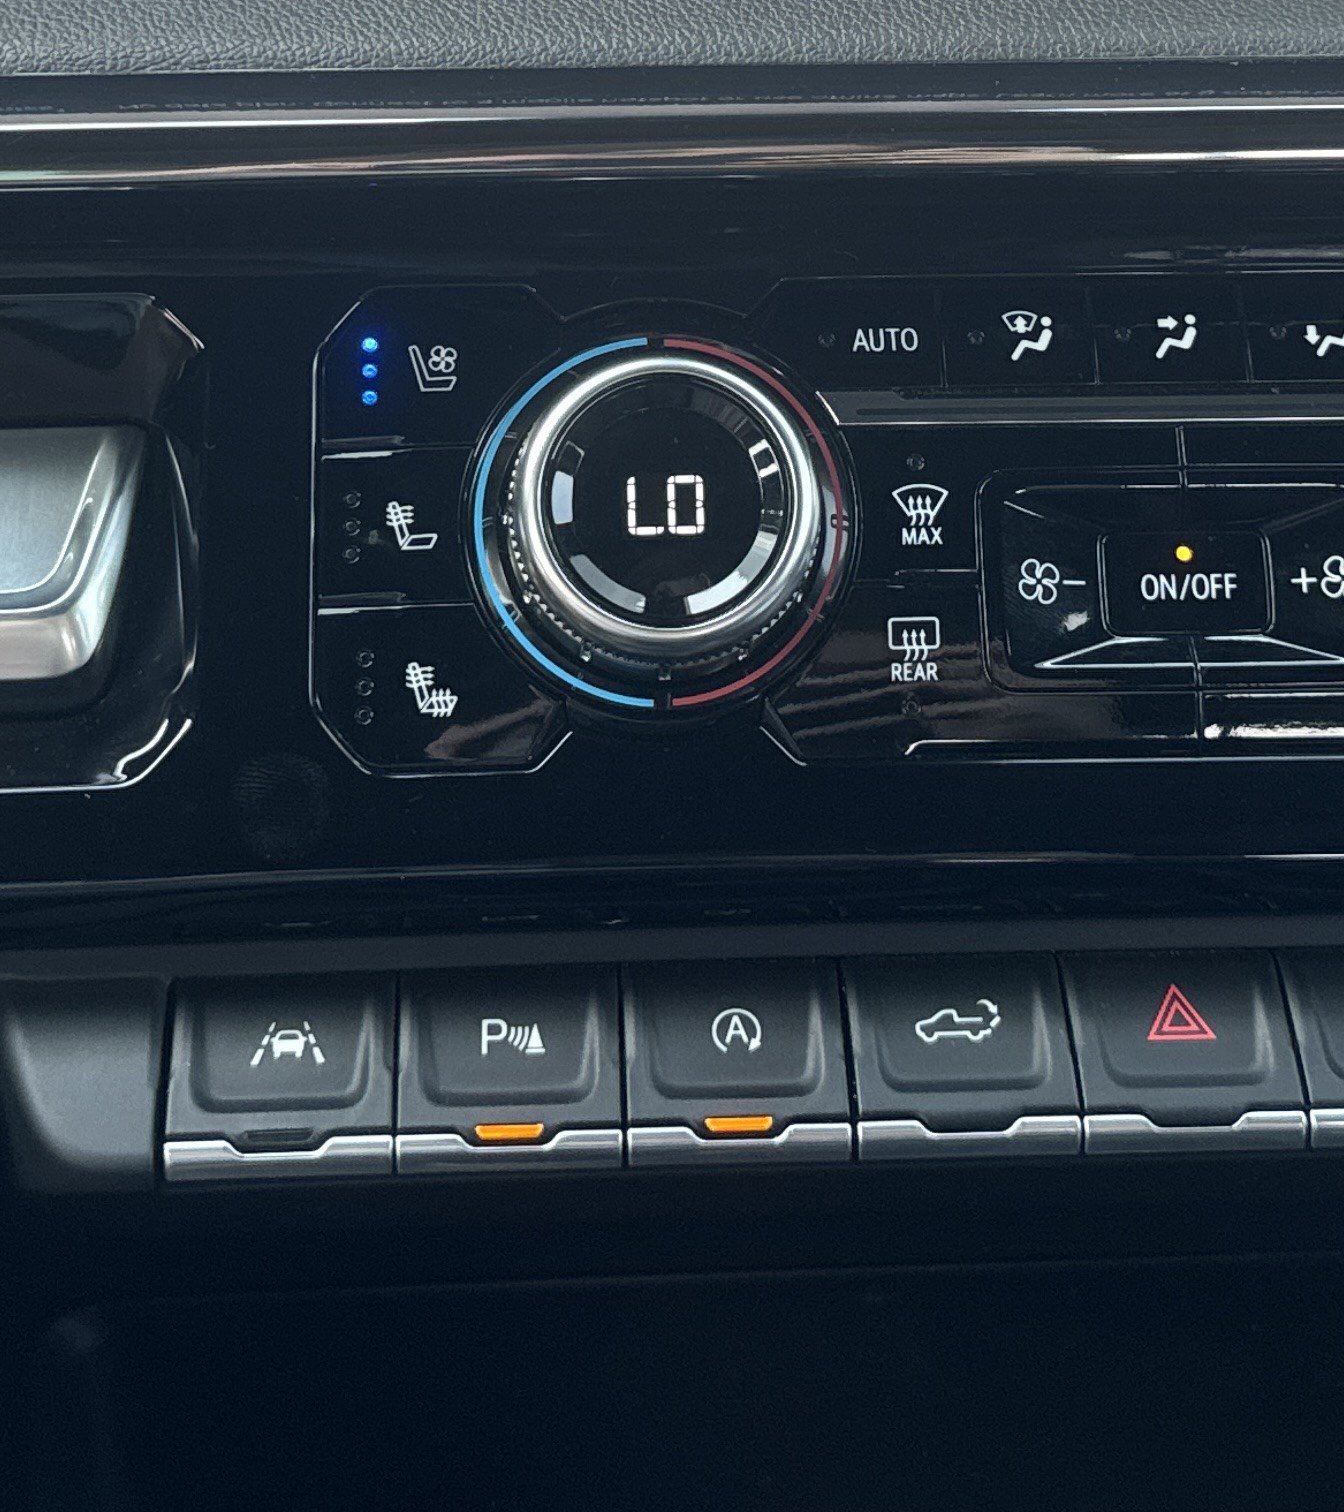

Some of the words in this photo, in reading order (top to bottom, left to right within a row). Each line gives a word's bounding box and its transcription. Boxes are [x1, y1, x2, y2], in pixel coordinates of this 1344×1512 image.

[853, 327, 919, 353] AUTO
[902, 525, 944, 546] MAX
[1140, 573, 1238, 601] ON/OFF
[891, 660, 939, 682] REAR
